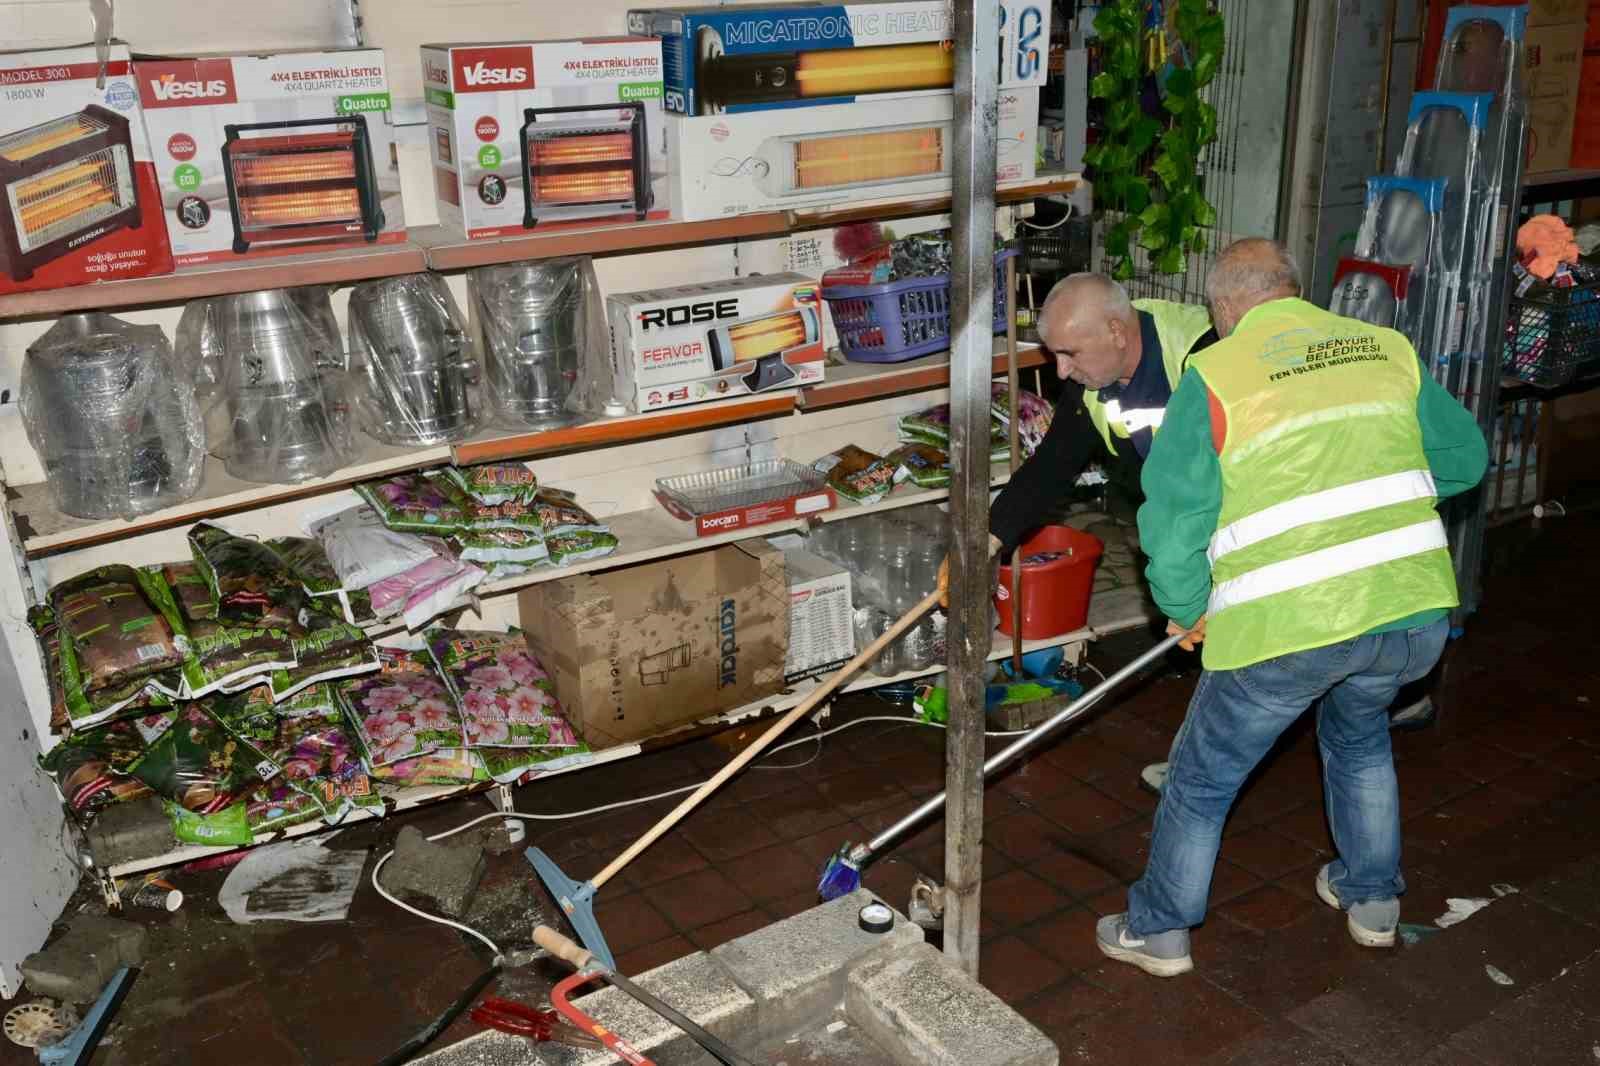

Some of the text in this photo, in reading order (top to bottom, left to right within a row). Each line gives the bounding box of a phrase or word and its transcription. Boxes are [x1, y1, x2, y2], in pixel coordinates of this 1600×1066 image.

[725, 14, 881, 46] MICATRONIC
[885, 10, 946, 34] HEAT
[1, 67, 72, 83] MODEL 3001
[463, 60, 528, 86] Vesus
[150, 74, 227, 101] Vesus
[304, 79, 344, 91] QUARTZ
[345, 77, 383, 88] HEATER
[622, 86, 660, 97] Quattro
[5, 88, 46, 101] 1800 W
[343, 98, 387, 111] Quattro
[639, 298, 740, 330] ROSE
[642, 342, 704, 363] FERVOR
[1305, 344, 1381, 362] BELEDİYESİ
[1307, 336, 1375, 354] ESENYURT
[1269, 370, 1291, 382] FEN
[702, 514, 739, 529] borcam
